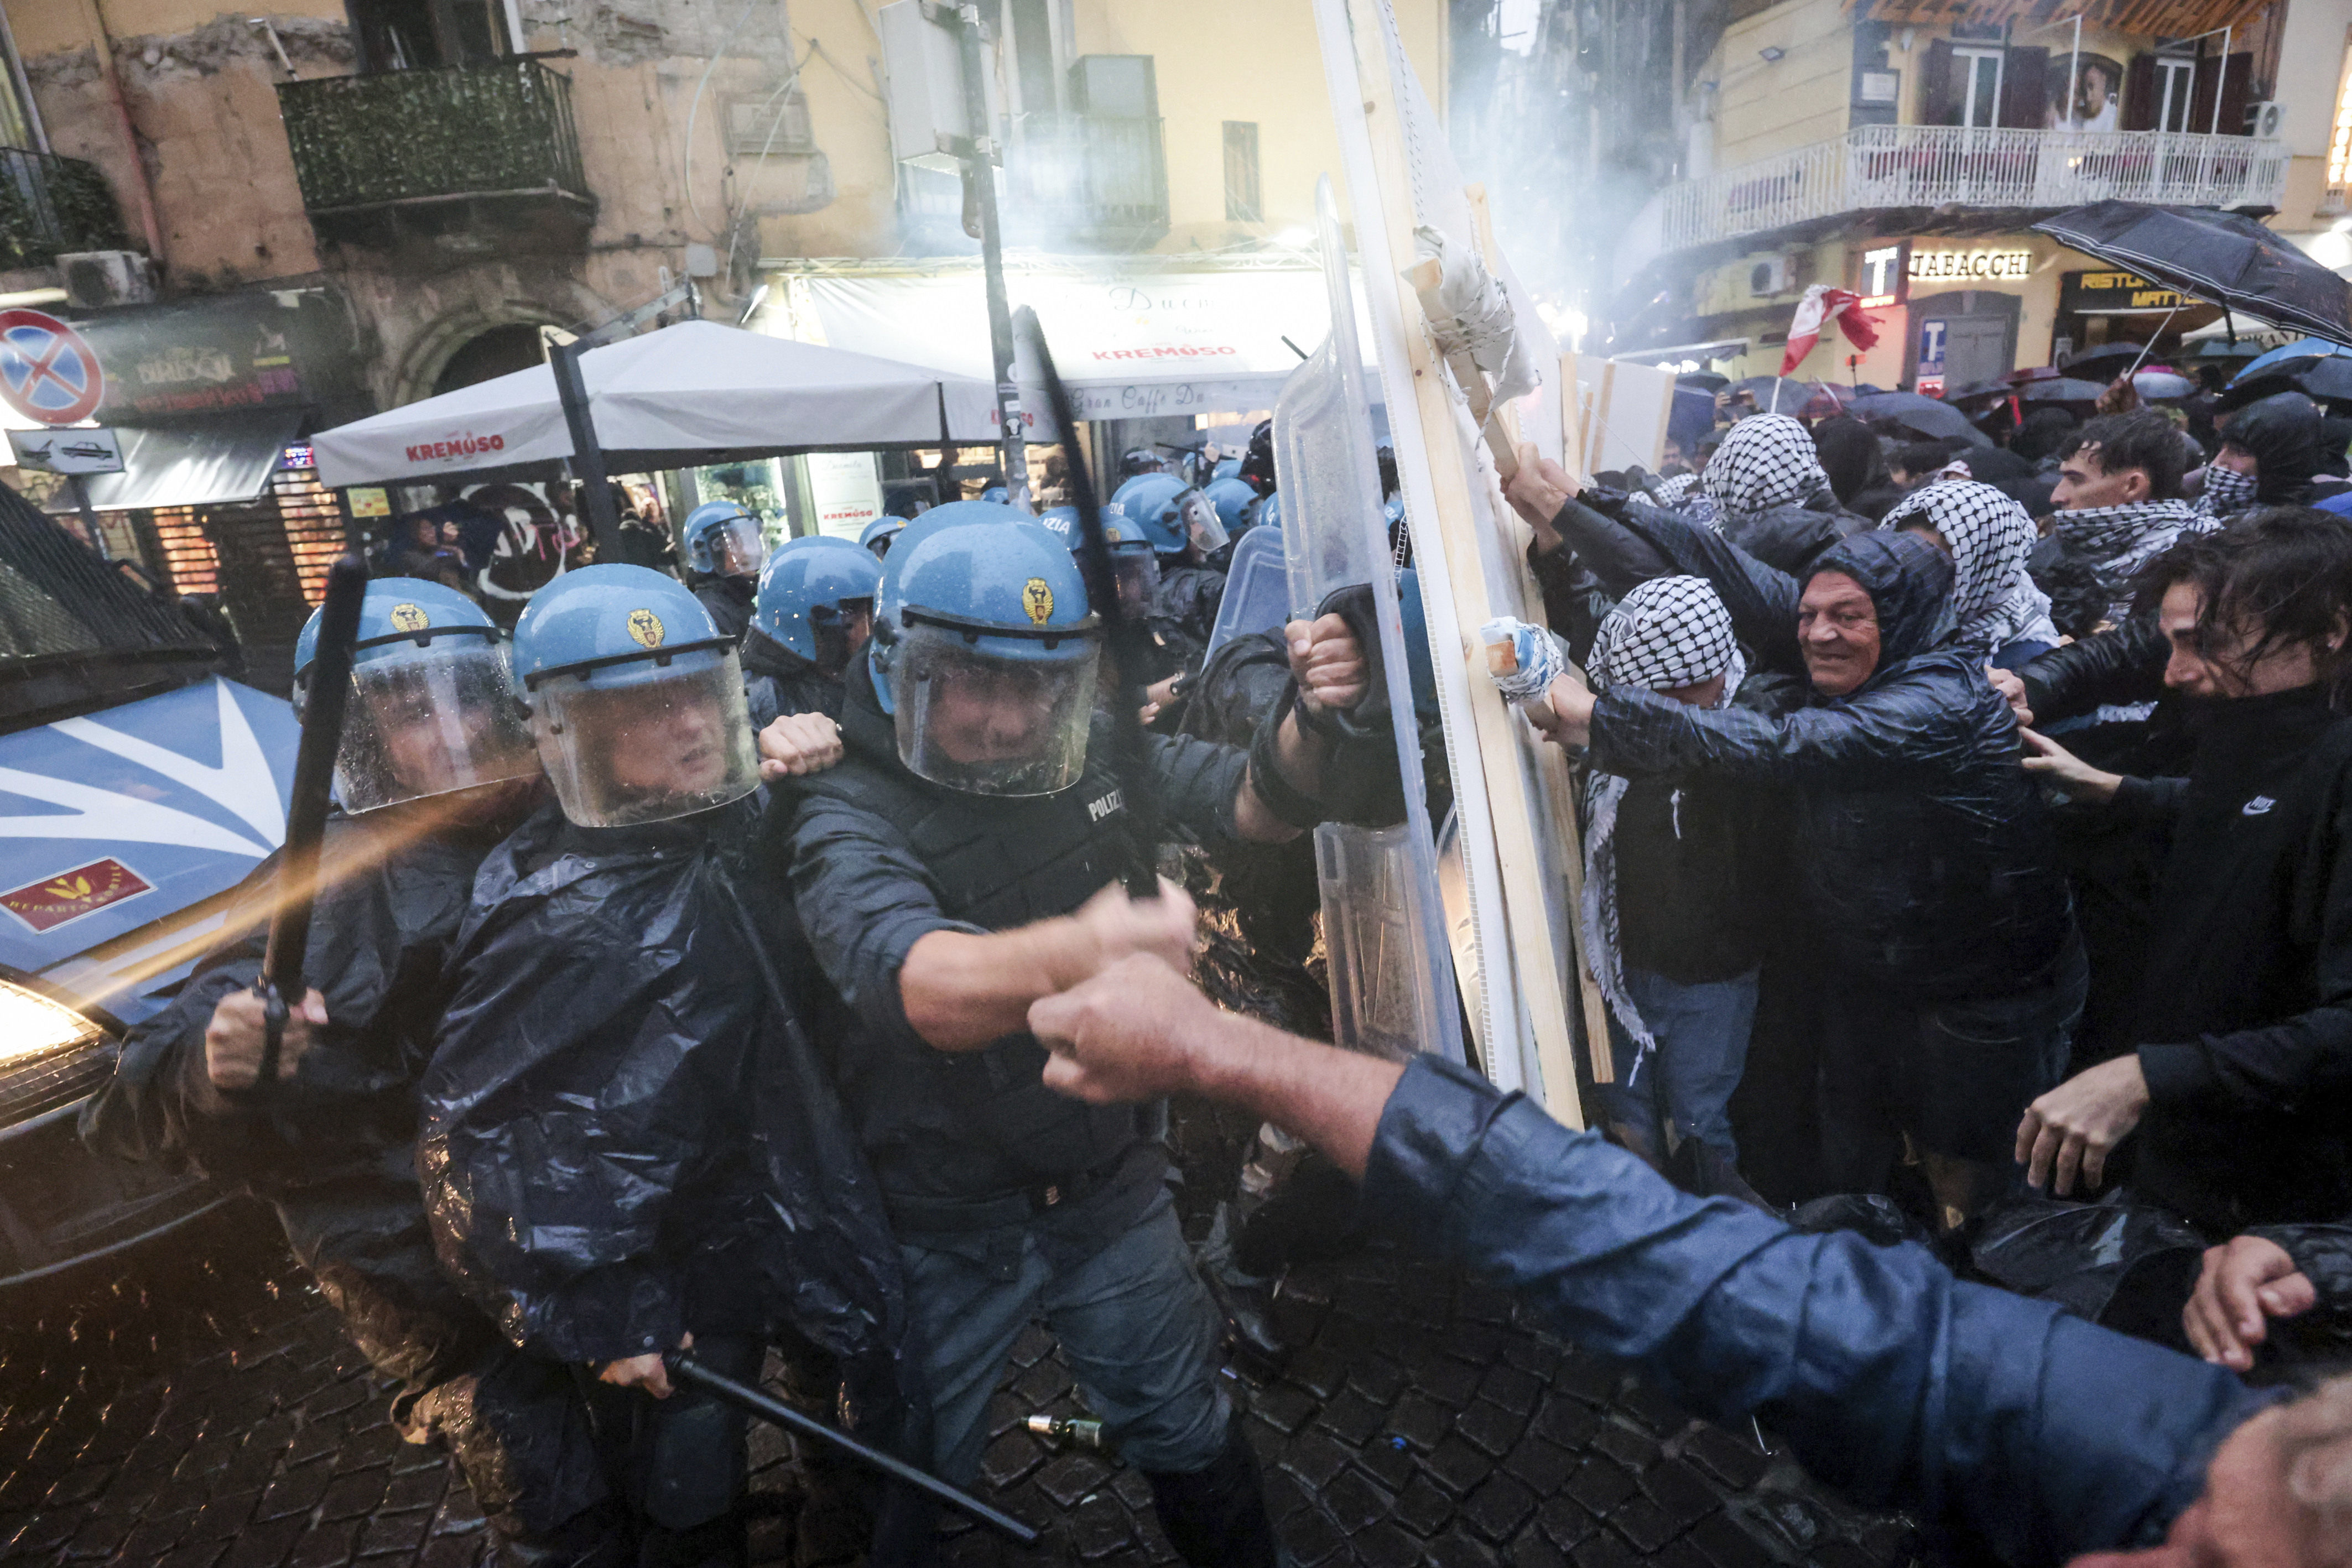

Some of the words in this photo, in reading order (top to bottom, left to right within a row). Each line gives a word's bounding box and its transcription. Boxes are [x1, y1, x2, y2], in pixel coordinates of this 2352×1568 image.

[1865, 247, 1898, 296] T
[1909, 253, 2033, 277] TABACCHI
[1925, 322, 1945, 361] T
[1088, 789, 1122, 822] POLIZI
[10, 901, 89, 912] REPARTO
